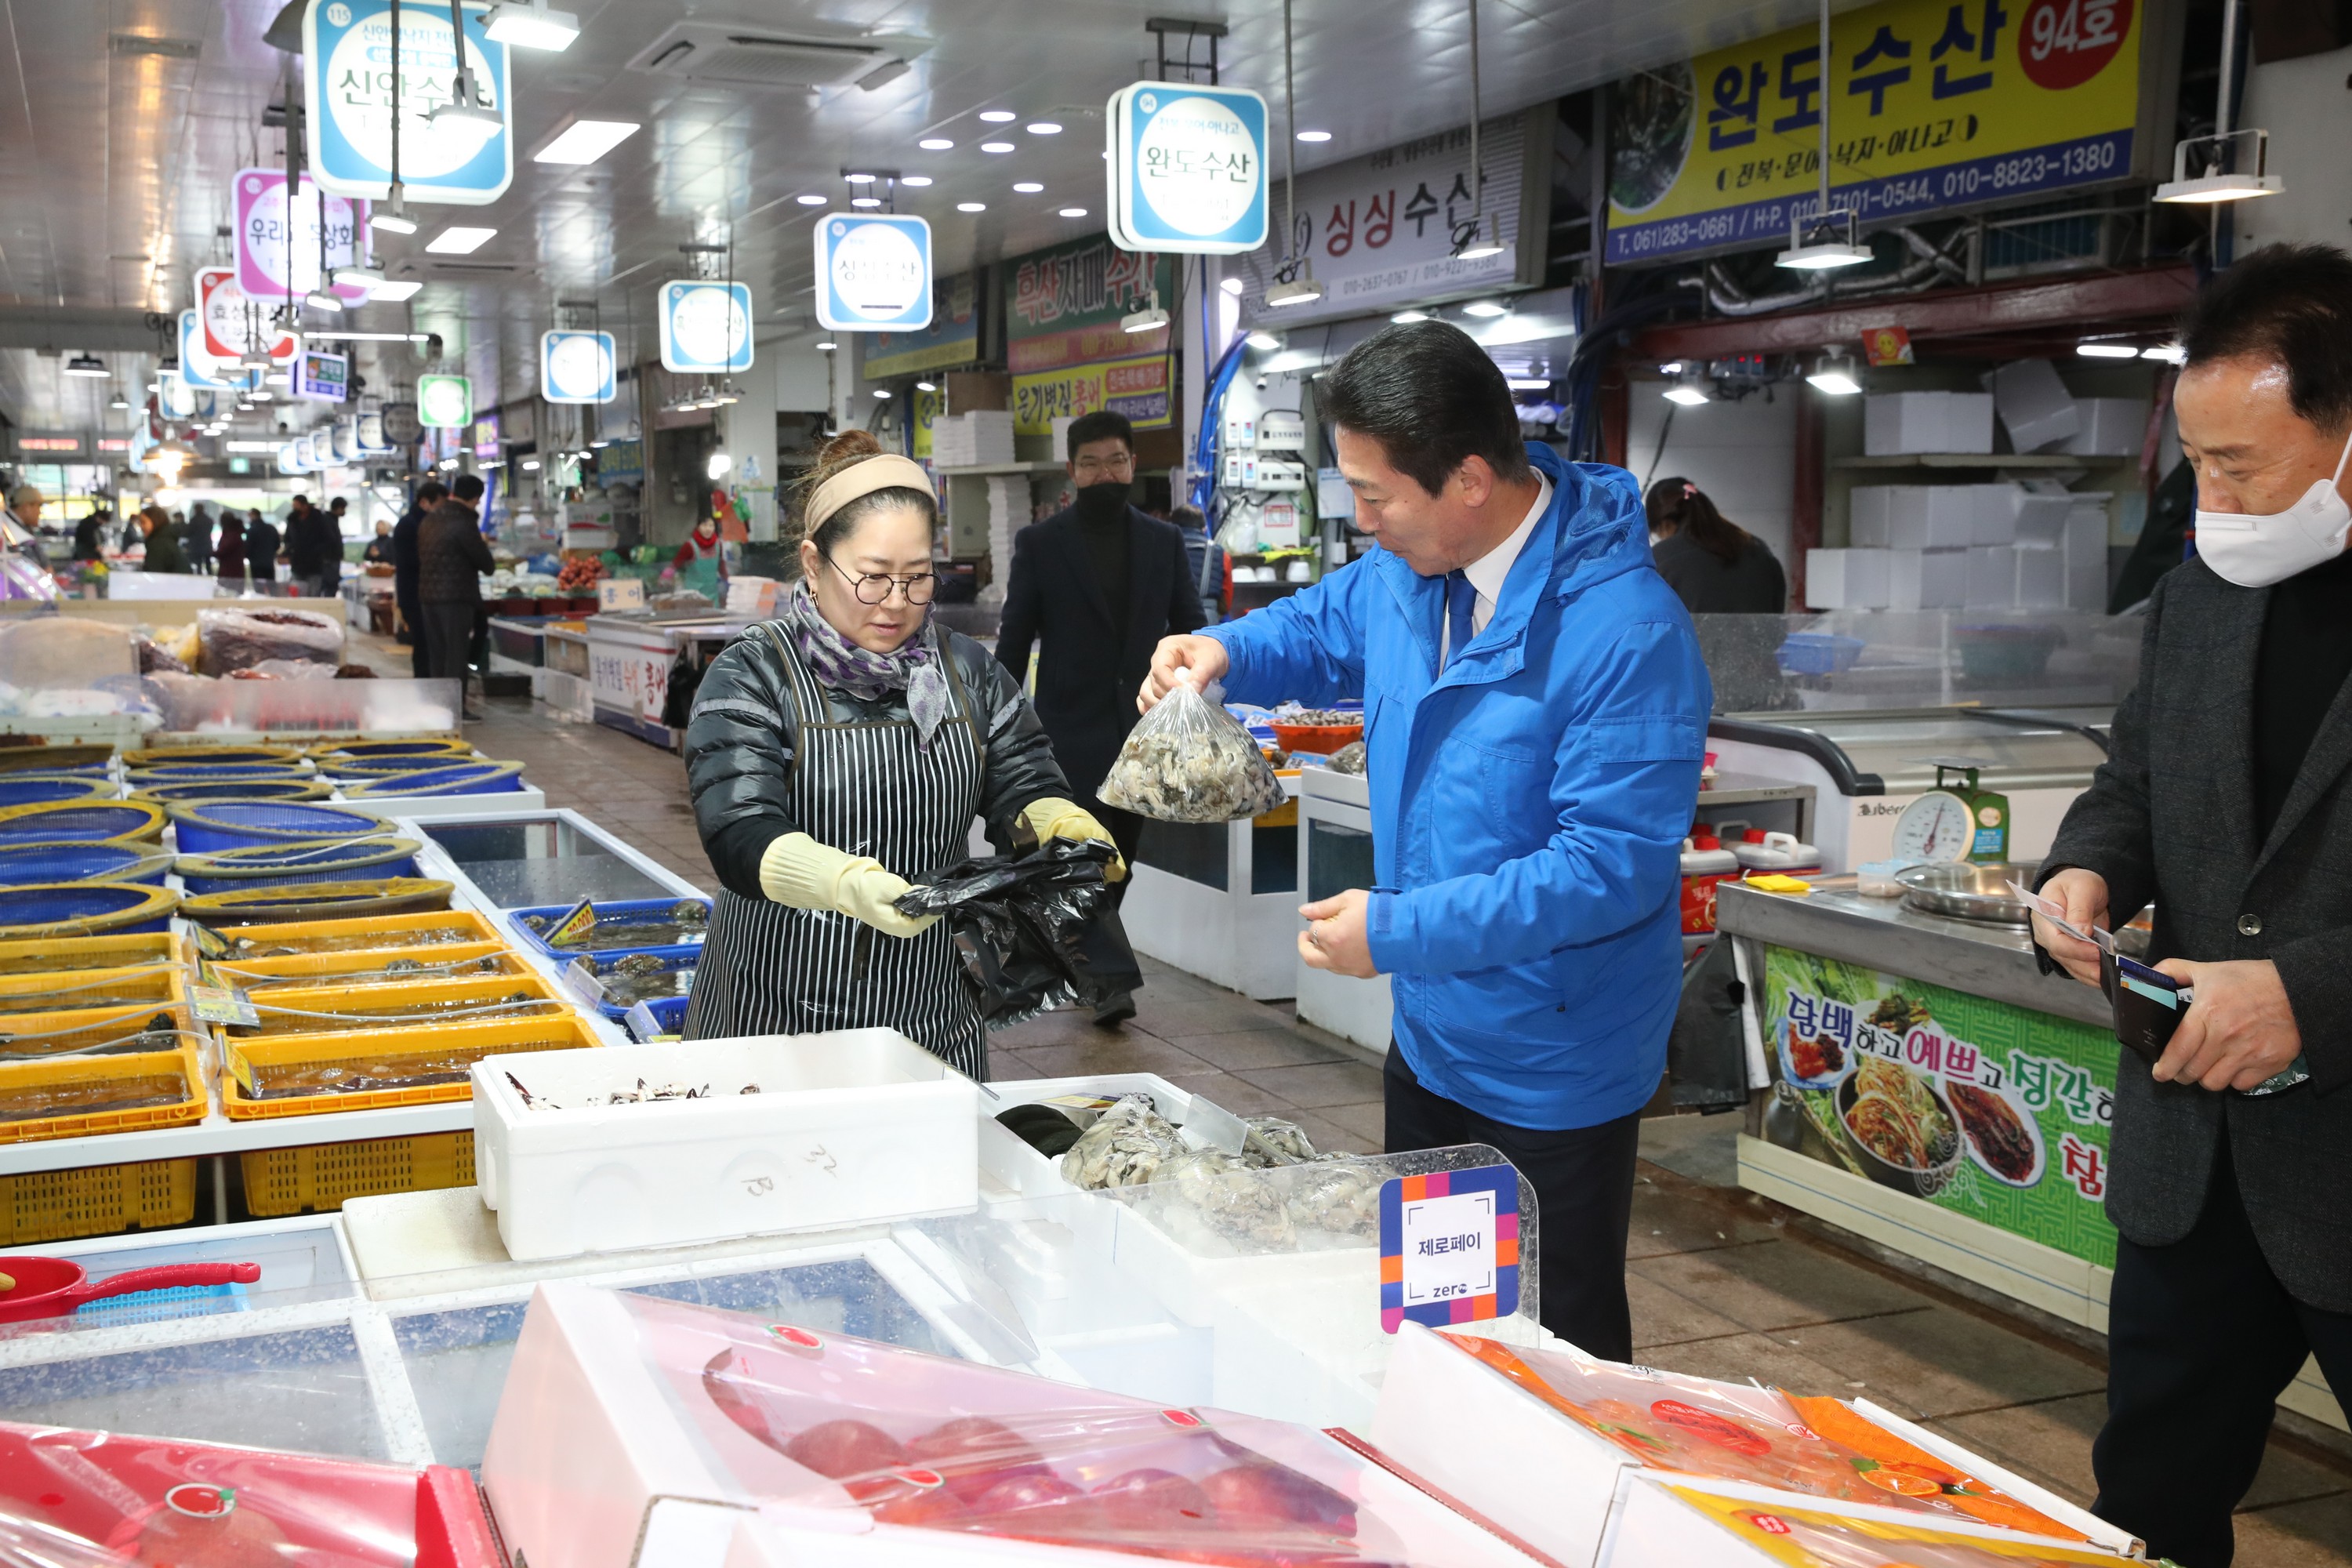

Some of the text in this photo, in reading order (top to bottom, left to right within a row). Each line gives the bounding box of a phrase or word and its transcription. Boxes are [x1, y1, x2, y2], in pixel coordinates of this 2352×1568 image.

[2030, 0, 2118, 60] 94호
[1707, 0, 2008, 151] 완도수산
[1146, 147, 1250, 183] 완도수산
[1943, 140, 2115, 197] 010-8823-1380
[1788, 991, 1903, 1060] 담백하고
[1907, 1029, 2002, 1089] 예쁘고
[1417, 1232, 1481, 1256] 제로페이
